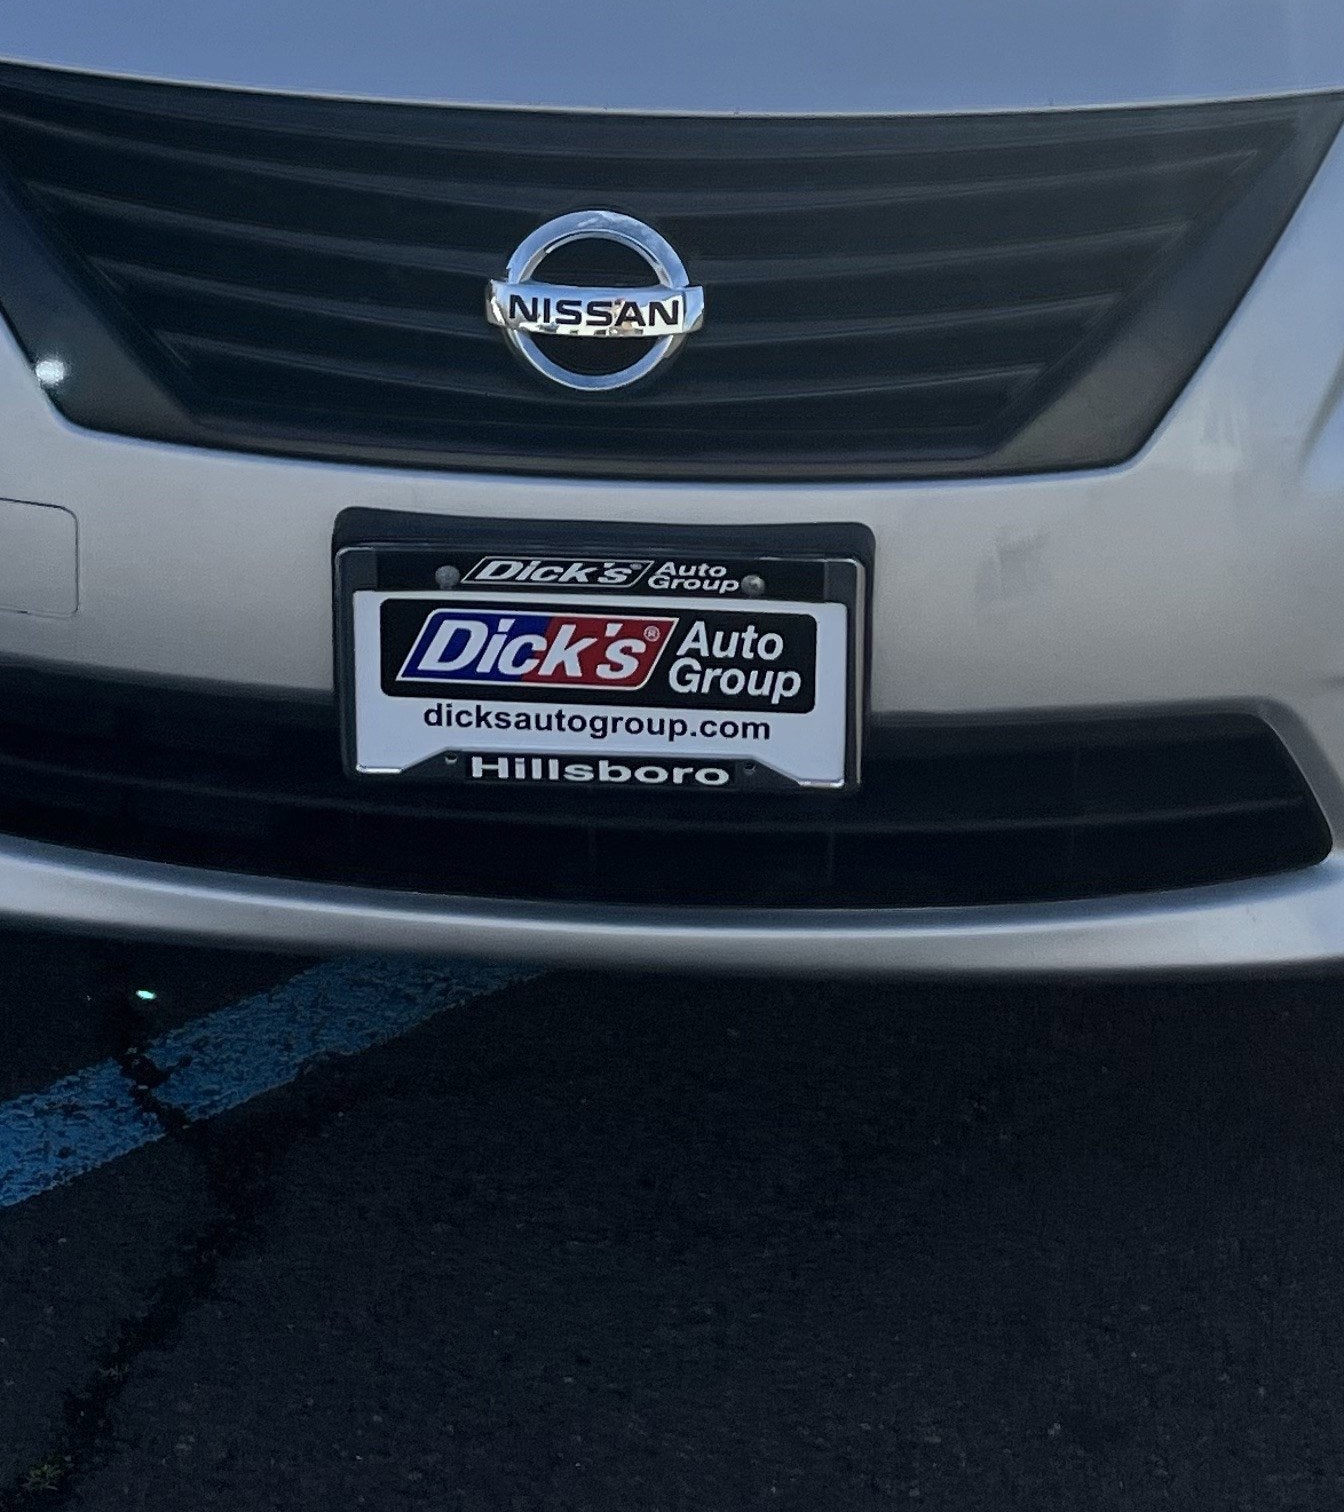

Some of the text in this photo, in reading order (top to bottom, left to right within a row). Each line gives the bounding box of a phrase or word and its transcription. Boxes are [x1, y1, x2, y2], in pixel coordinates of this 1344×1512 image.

[509, 294, 680, 326] NISSAN
[474, 559, 633, 584] Dick's
[648, 575, 740, 594] Group
[656, 561, 727, 578] Auto
[417, 617, 645, 681] Dick's
[676, 620, 784, 662] Auto
[668, 657, 802, 704] Group
[423, 703, 771, 741] dicksautogroup.com
[471, 756, 730, 785] Hillsboro
